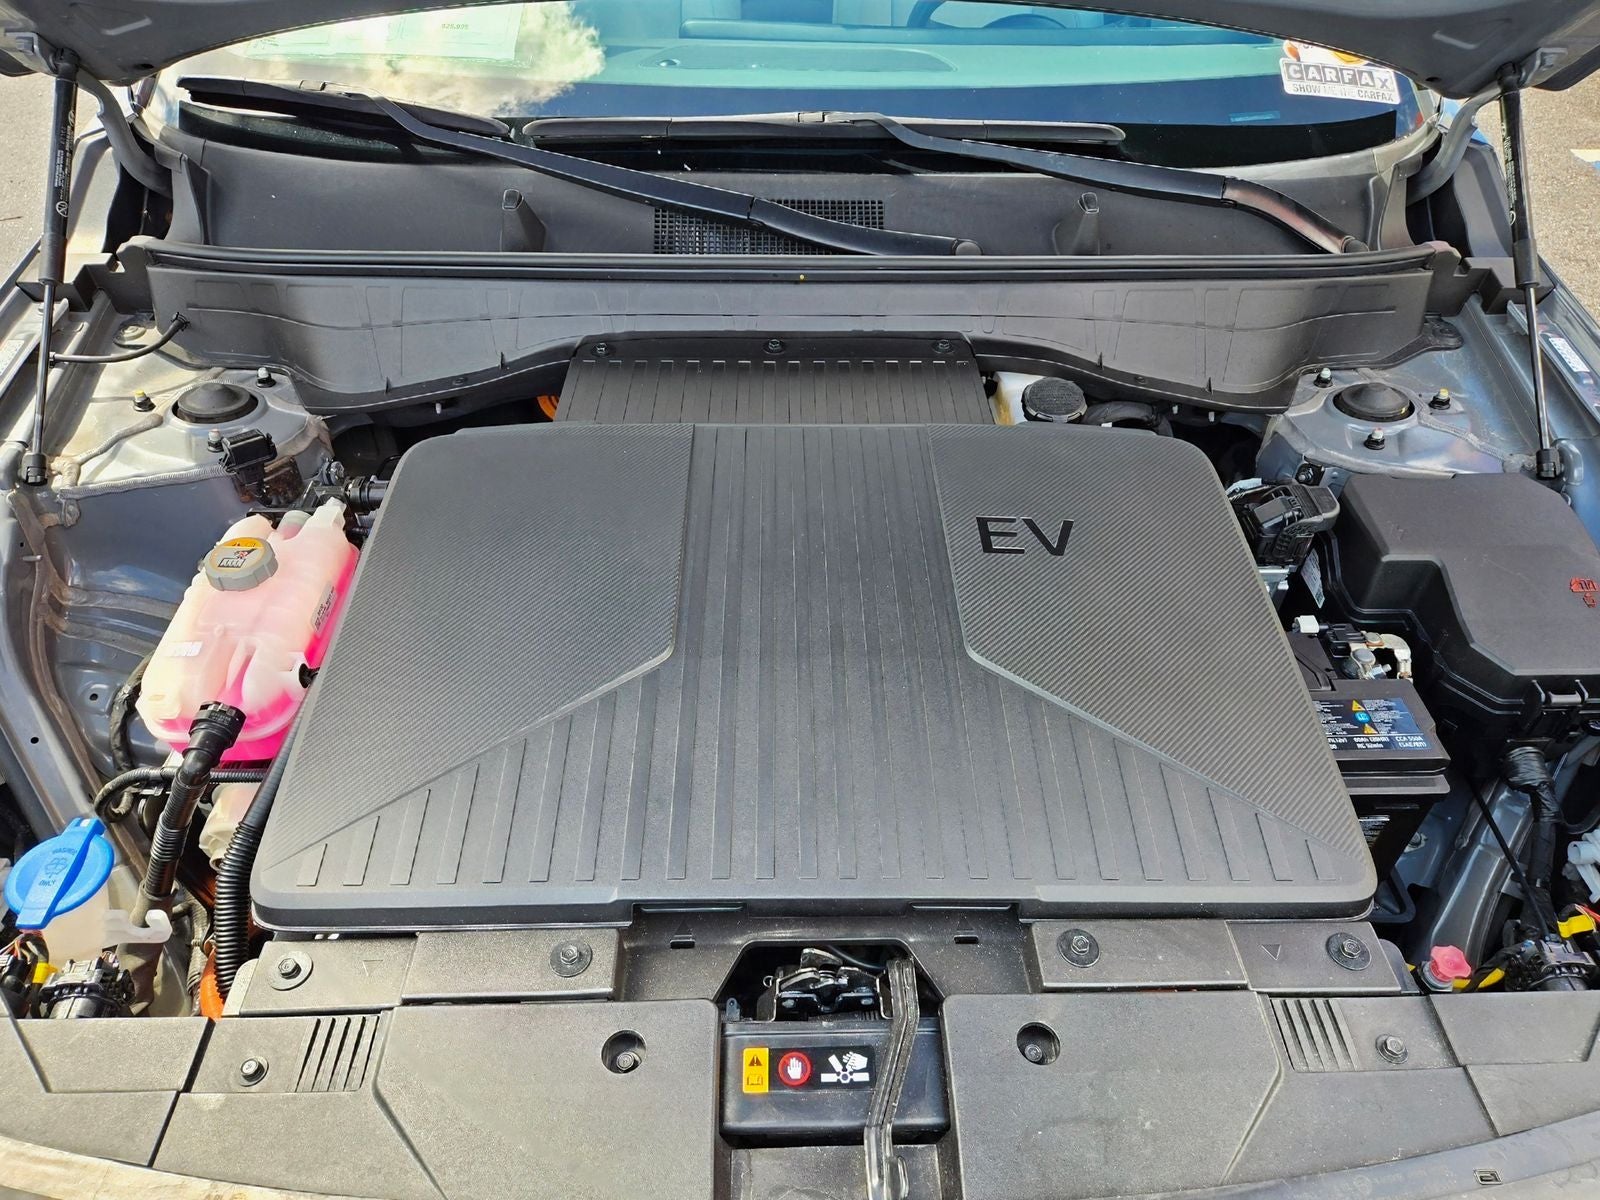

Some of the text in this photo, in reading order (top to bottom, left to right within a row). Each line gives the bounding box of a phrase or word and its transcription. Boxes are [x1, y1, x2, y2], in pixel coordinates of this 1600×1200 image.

[1287, 64, 1391, 90] CARFAX
[1292, 83, 1320, 94] SHOW
[1357, 90, 1395, 101] CARFAX
[976, 515, 1075, 556] EV
